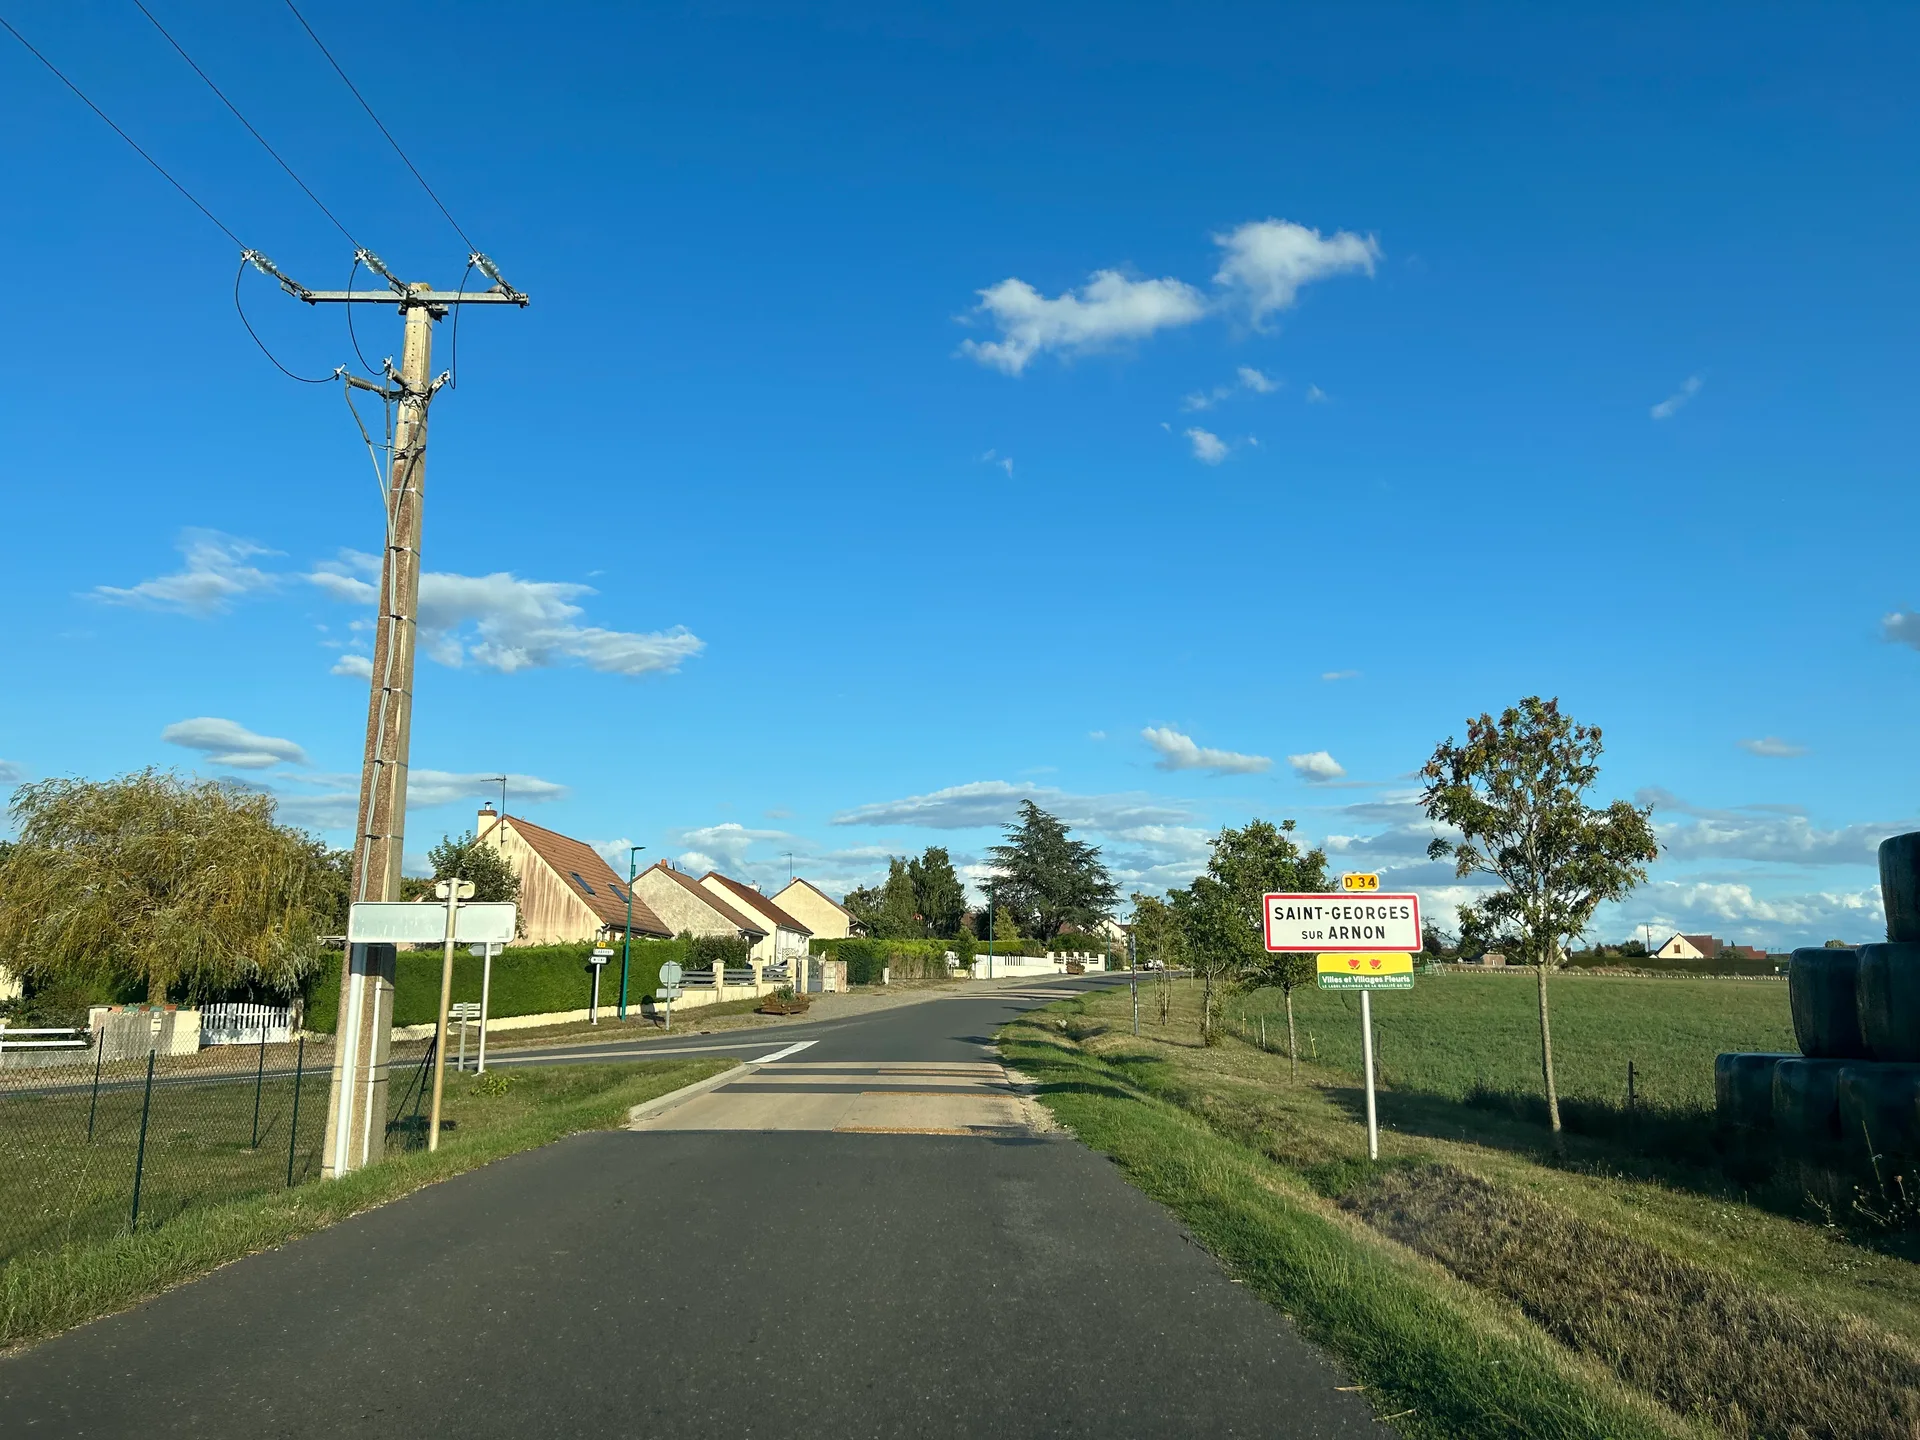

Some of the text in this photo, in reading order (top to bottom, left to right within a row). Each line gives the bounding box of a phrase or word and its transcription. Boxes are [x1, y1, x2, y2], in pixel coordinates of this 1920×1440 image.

[1345, 877, 1376, 888] D 34
[1274, 906, 1410, 920] SAINT-GEORGES
[1301, 925, 1386, 940] SUR ARNON
[1352, 976, 1383, 984] Villages
[1384, 975, 1410, 983] Fleuris
